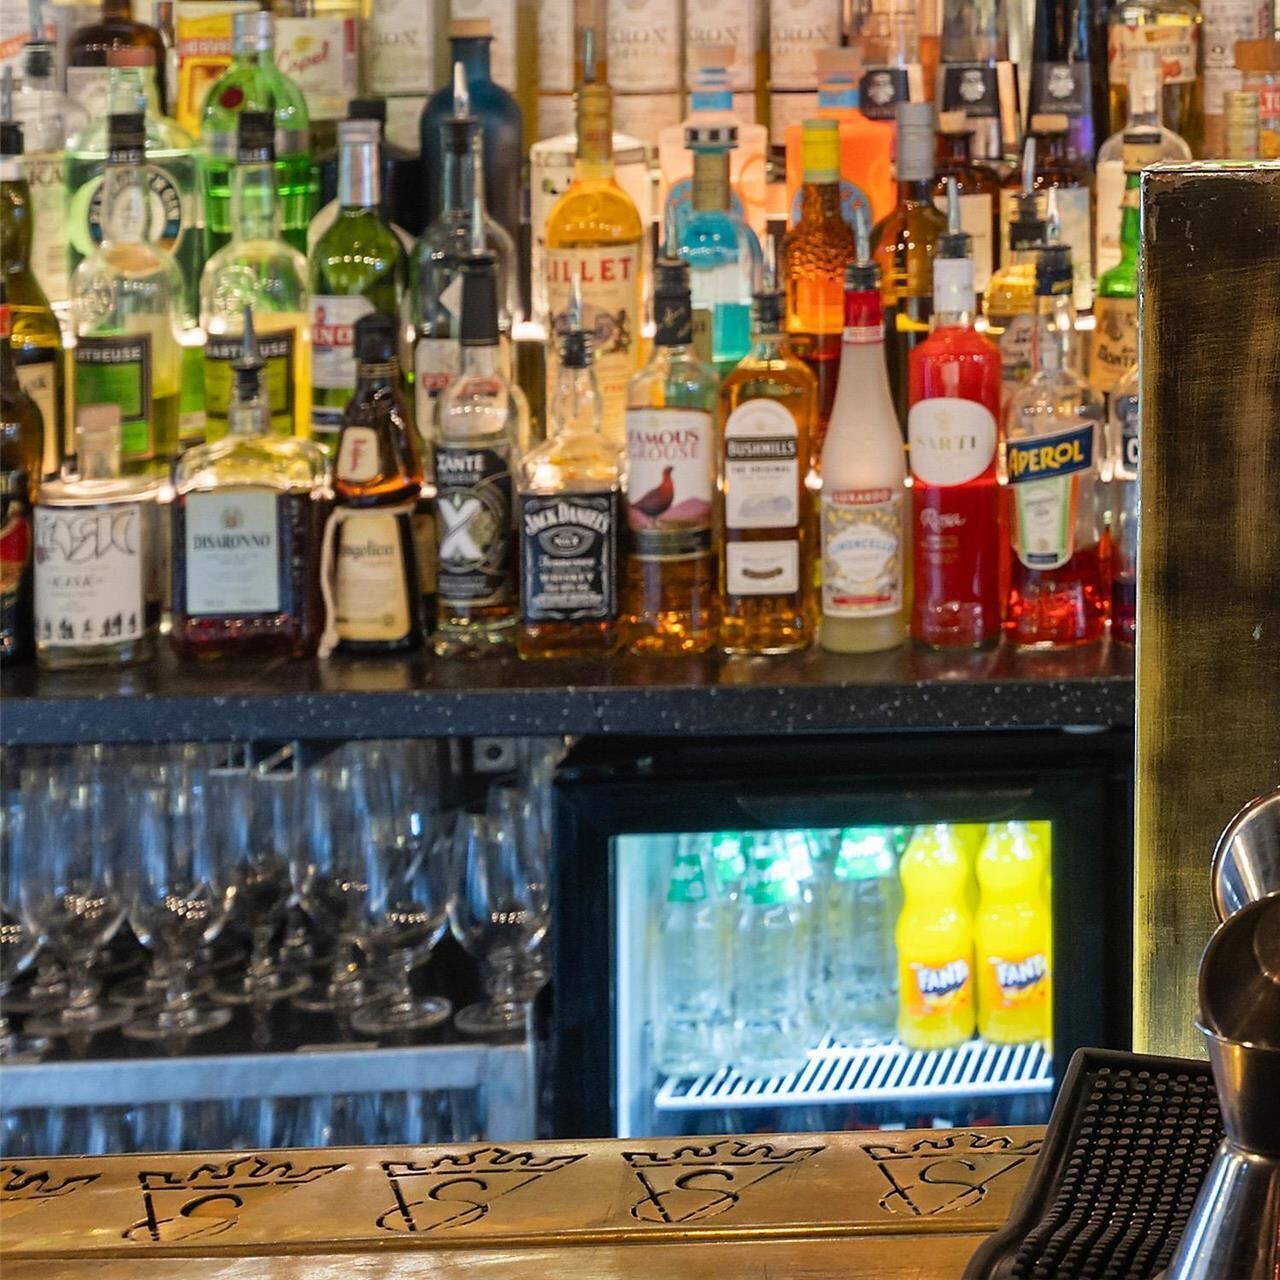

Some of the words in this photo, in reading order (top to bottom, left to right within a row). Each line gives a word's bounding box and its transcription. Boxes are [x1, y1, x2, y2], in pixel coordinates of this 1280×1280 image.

[727, 440, 796, 458] BUSHMILLS
[1008, 438, 1085, 477] APEROL
[192, 534, 272, 551] DISARONNO
